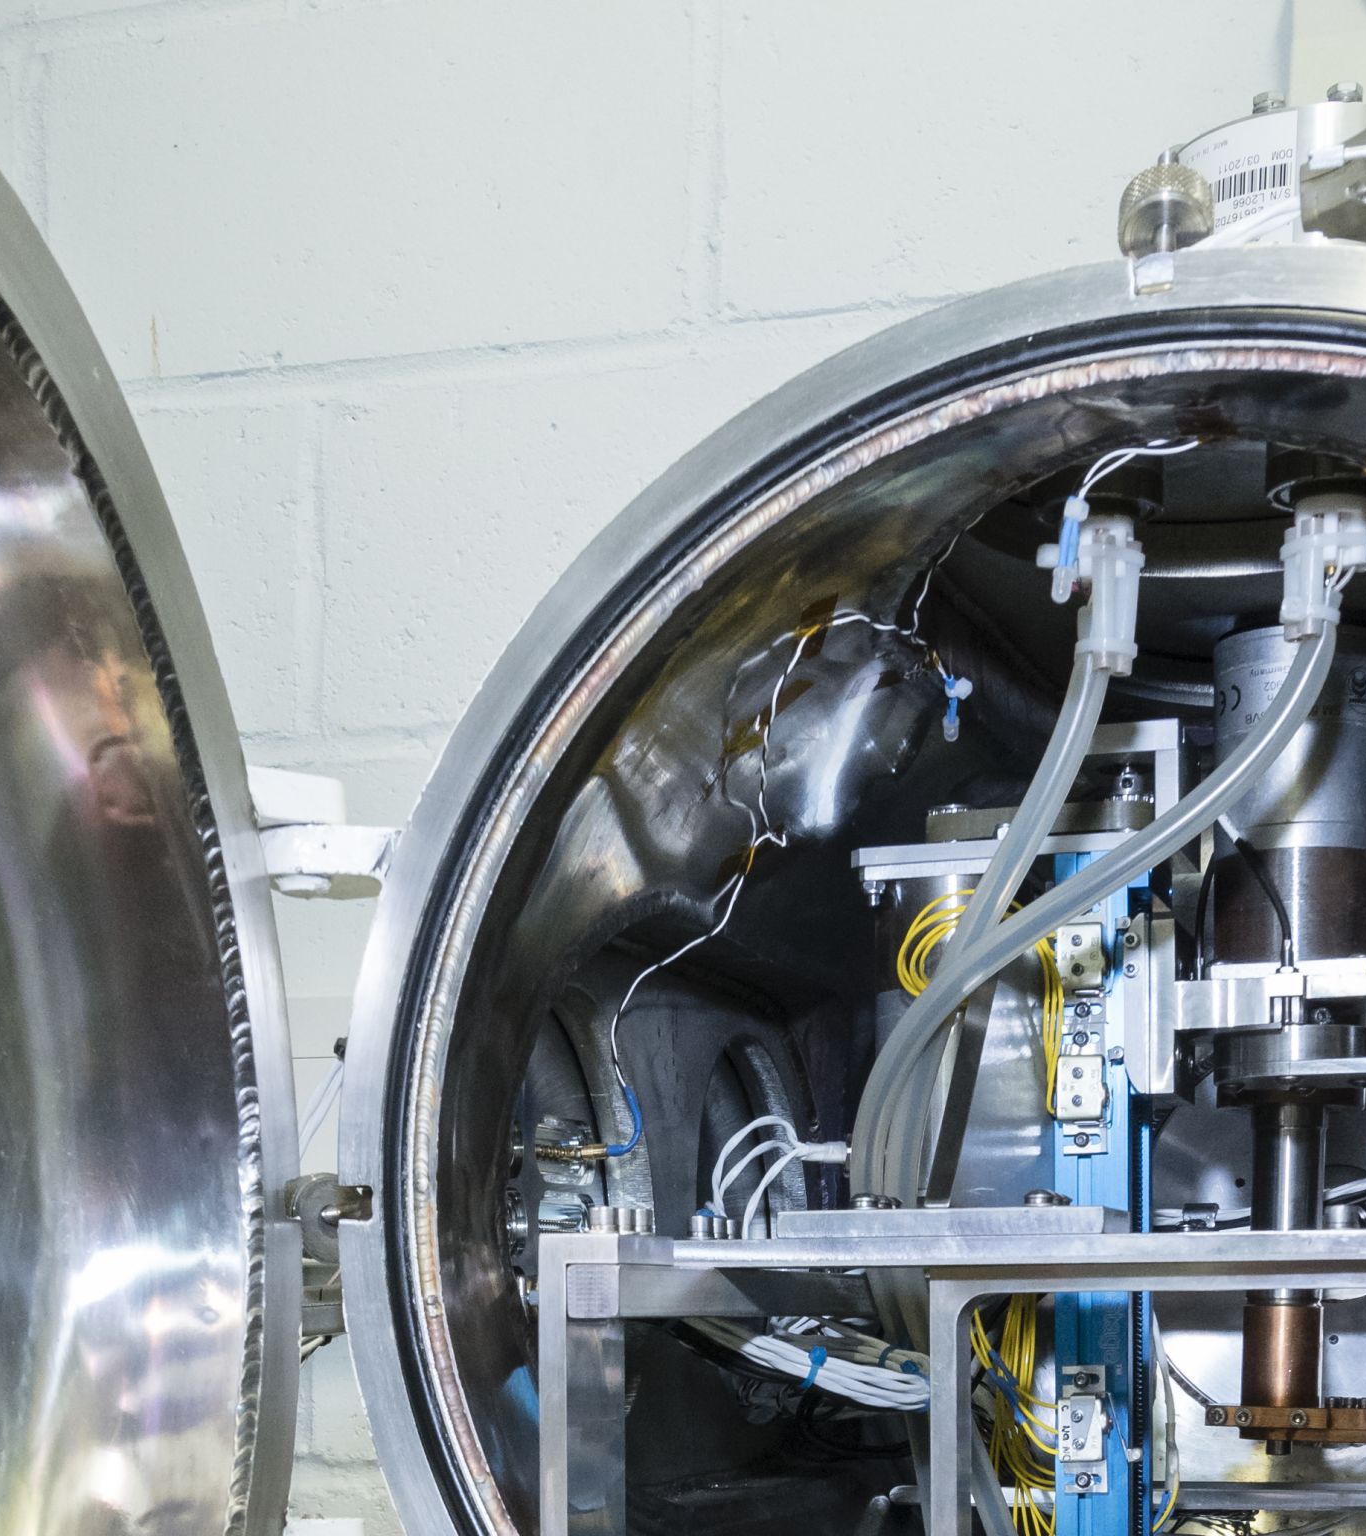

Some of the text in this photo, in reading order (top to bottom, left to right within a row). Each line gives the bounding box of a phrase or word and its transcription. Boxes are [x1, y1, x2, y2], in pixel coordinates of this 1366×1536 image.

[1218, 148, 1293, 175] DOM 03/2011
[1232, 188, 1291, 210] S/N L2066
